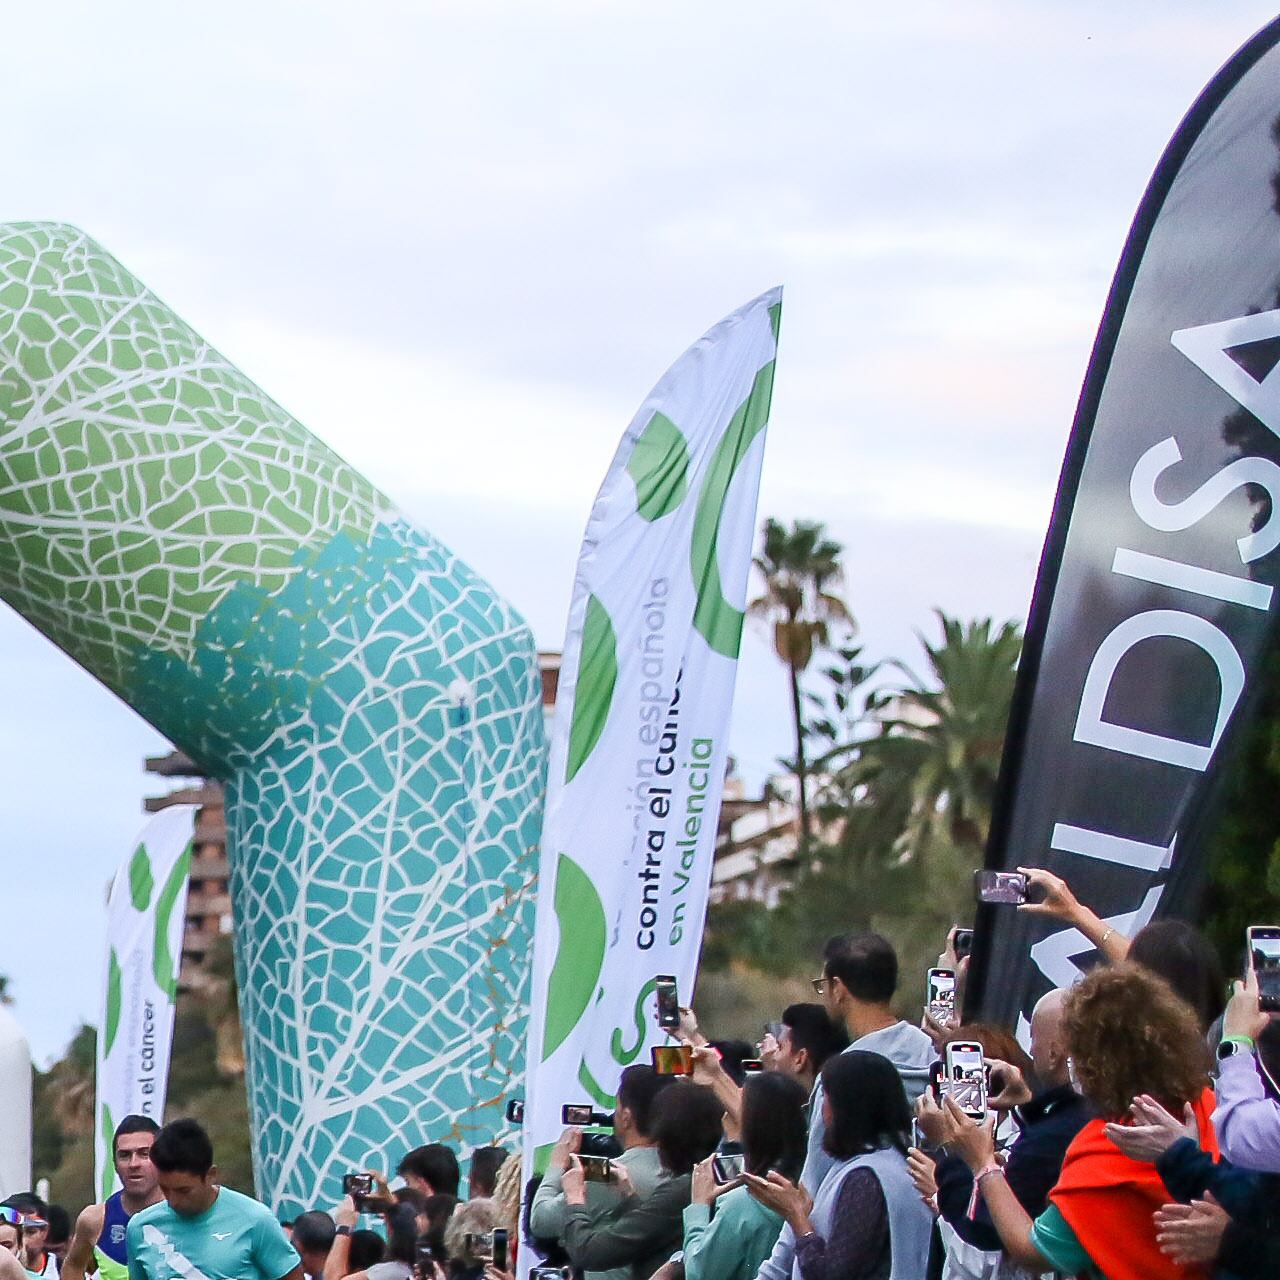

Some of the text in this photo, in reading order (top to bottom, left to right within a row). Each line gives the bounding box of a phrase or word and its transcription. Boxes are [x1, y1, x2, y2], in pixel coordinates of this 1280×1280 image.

[648, 787, 673, 820] el
[669, 737, 713, 946] en Valencia
[637, 830, 667, 951] contra
